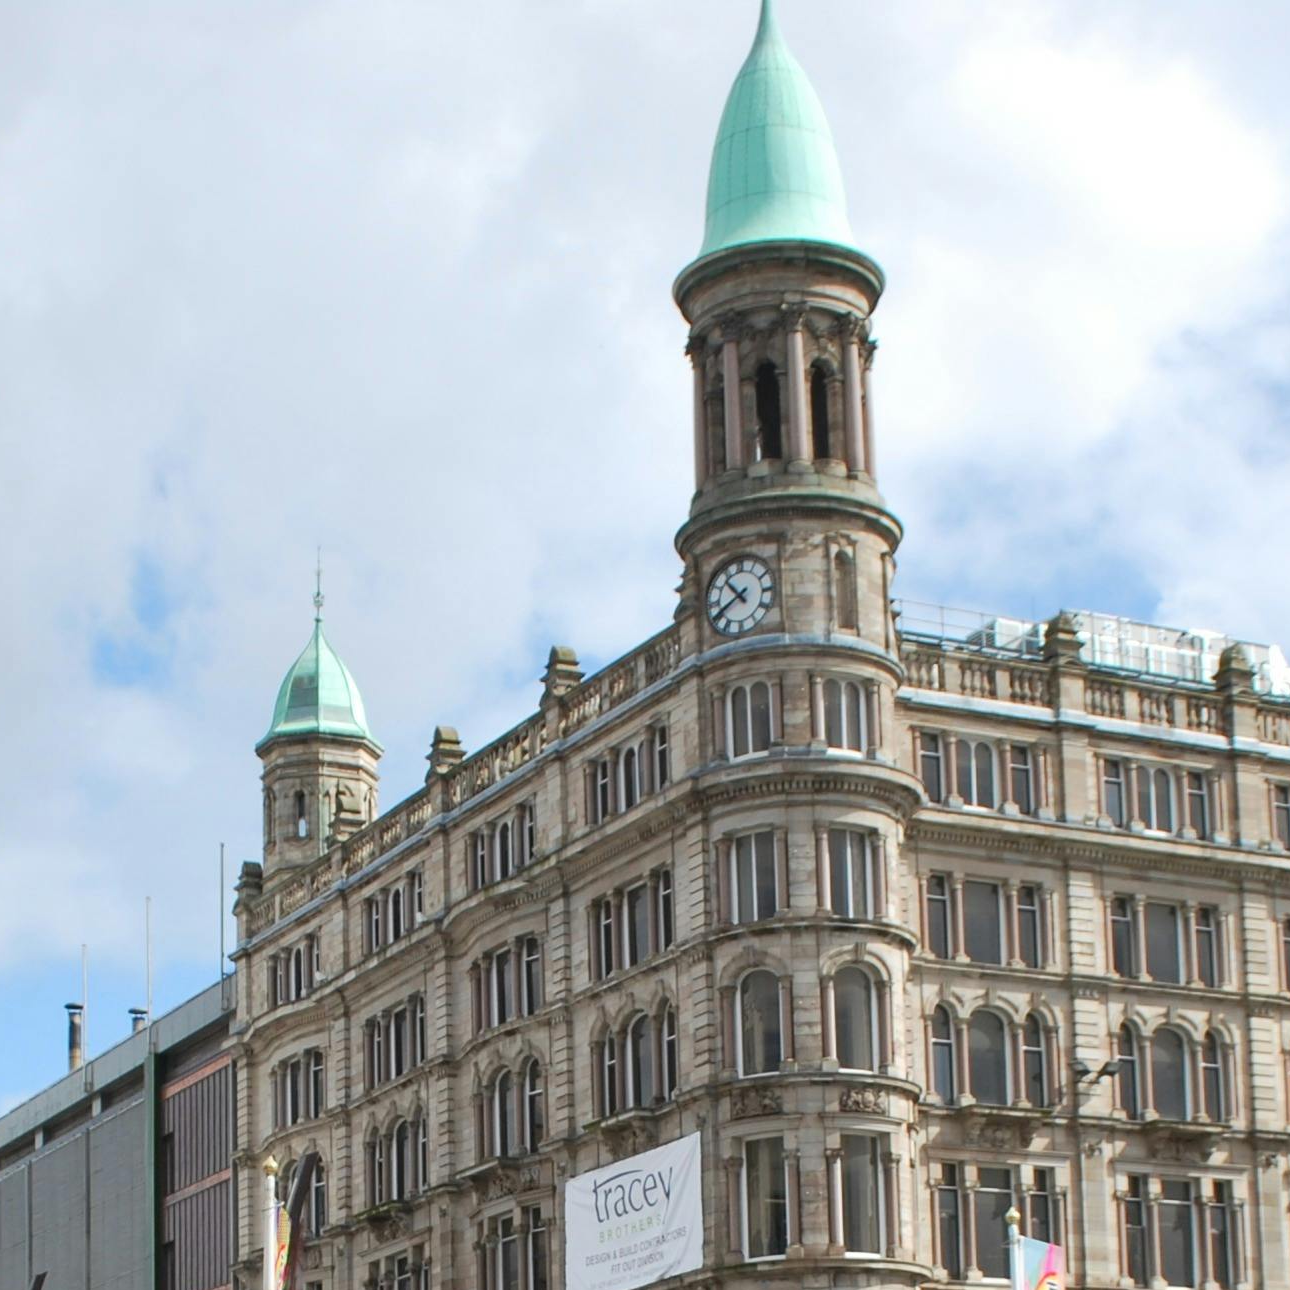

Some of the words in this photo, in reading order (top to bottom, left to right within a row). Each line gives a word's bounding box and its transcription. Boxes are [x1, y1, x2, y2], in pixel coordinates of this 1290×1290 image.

[593, 1166, 673, 1225] tracey
[599, 1213, 663, 1244] BROTHERS
[585, 1252, 611, 1267] DESIGN
